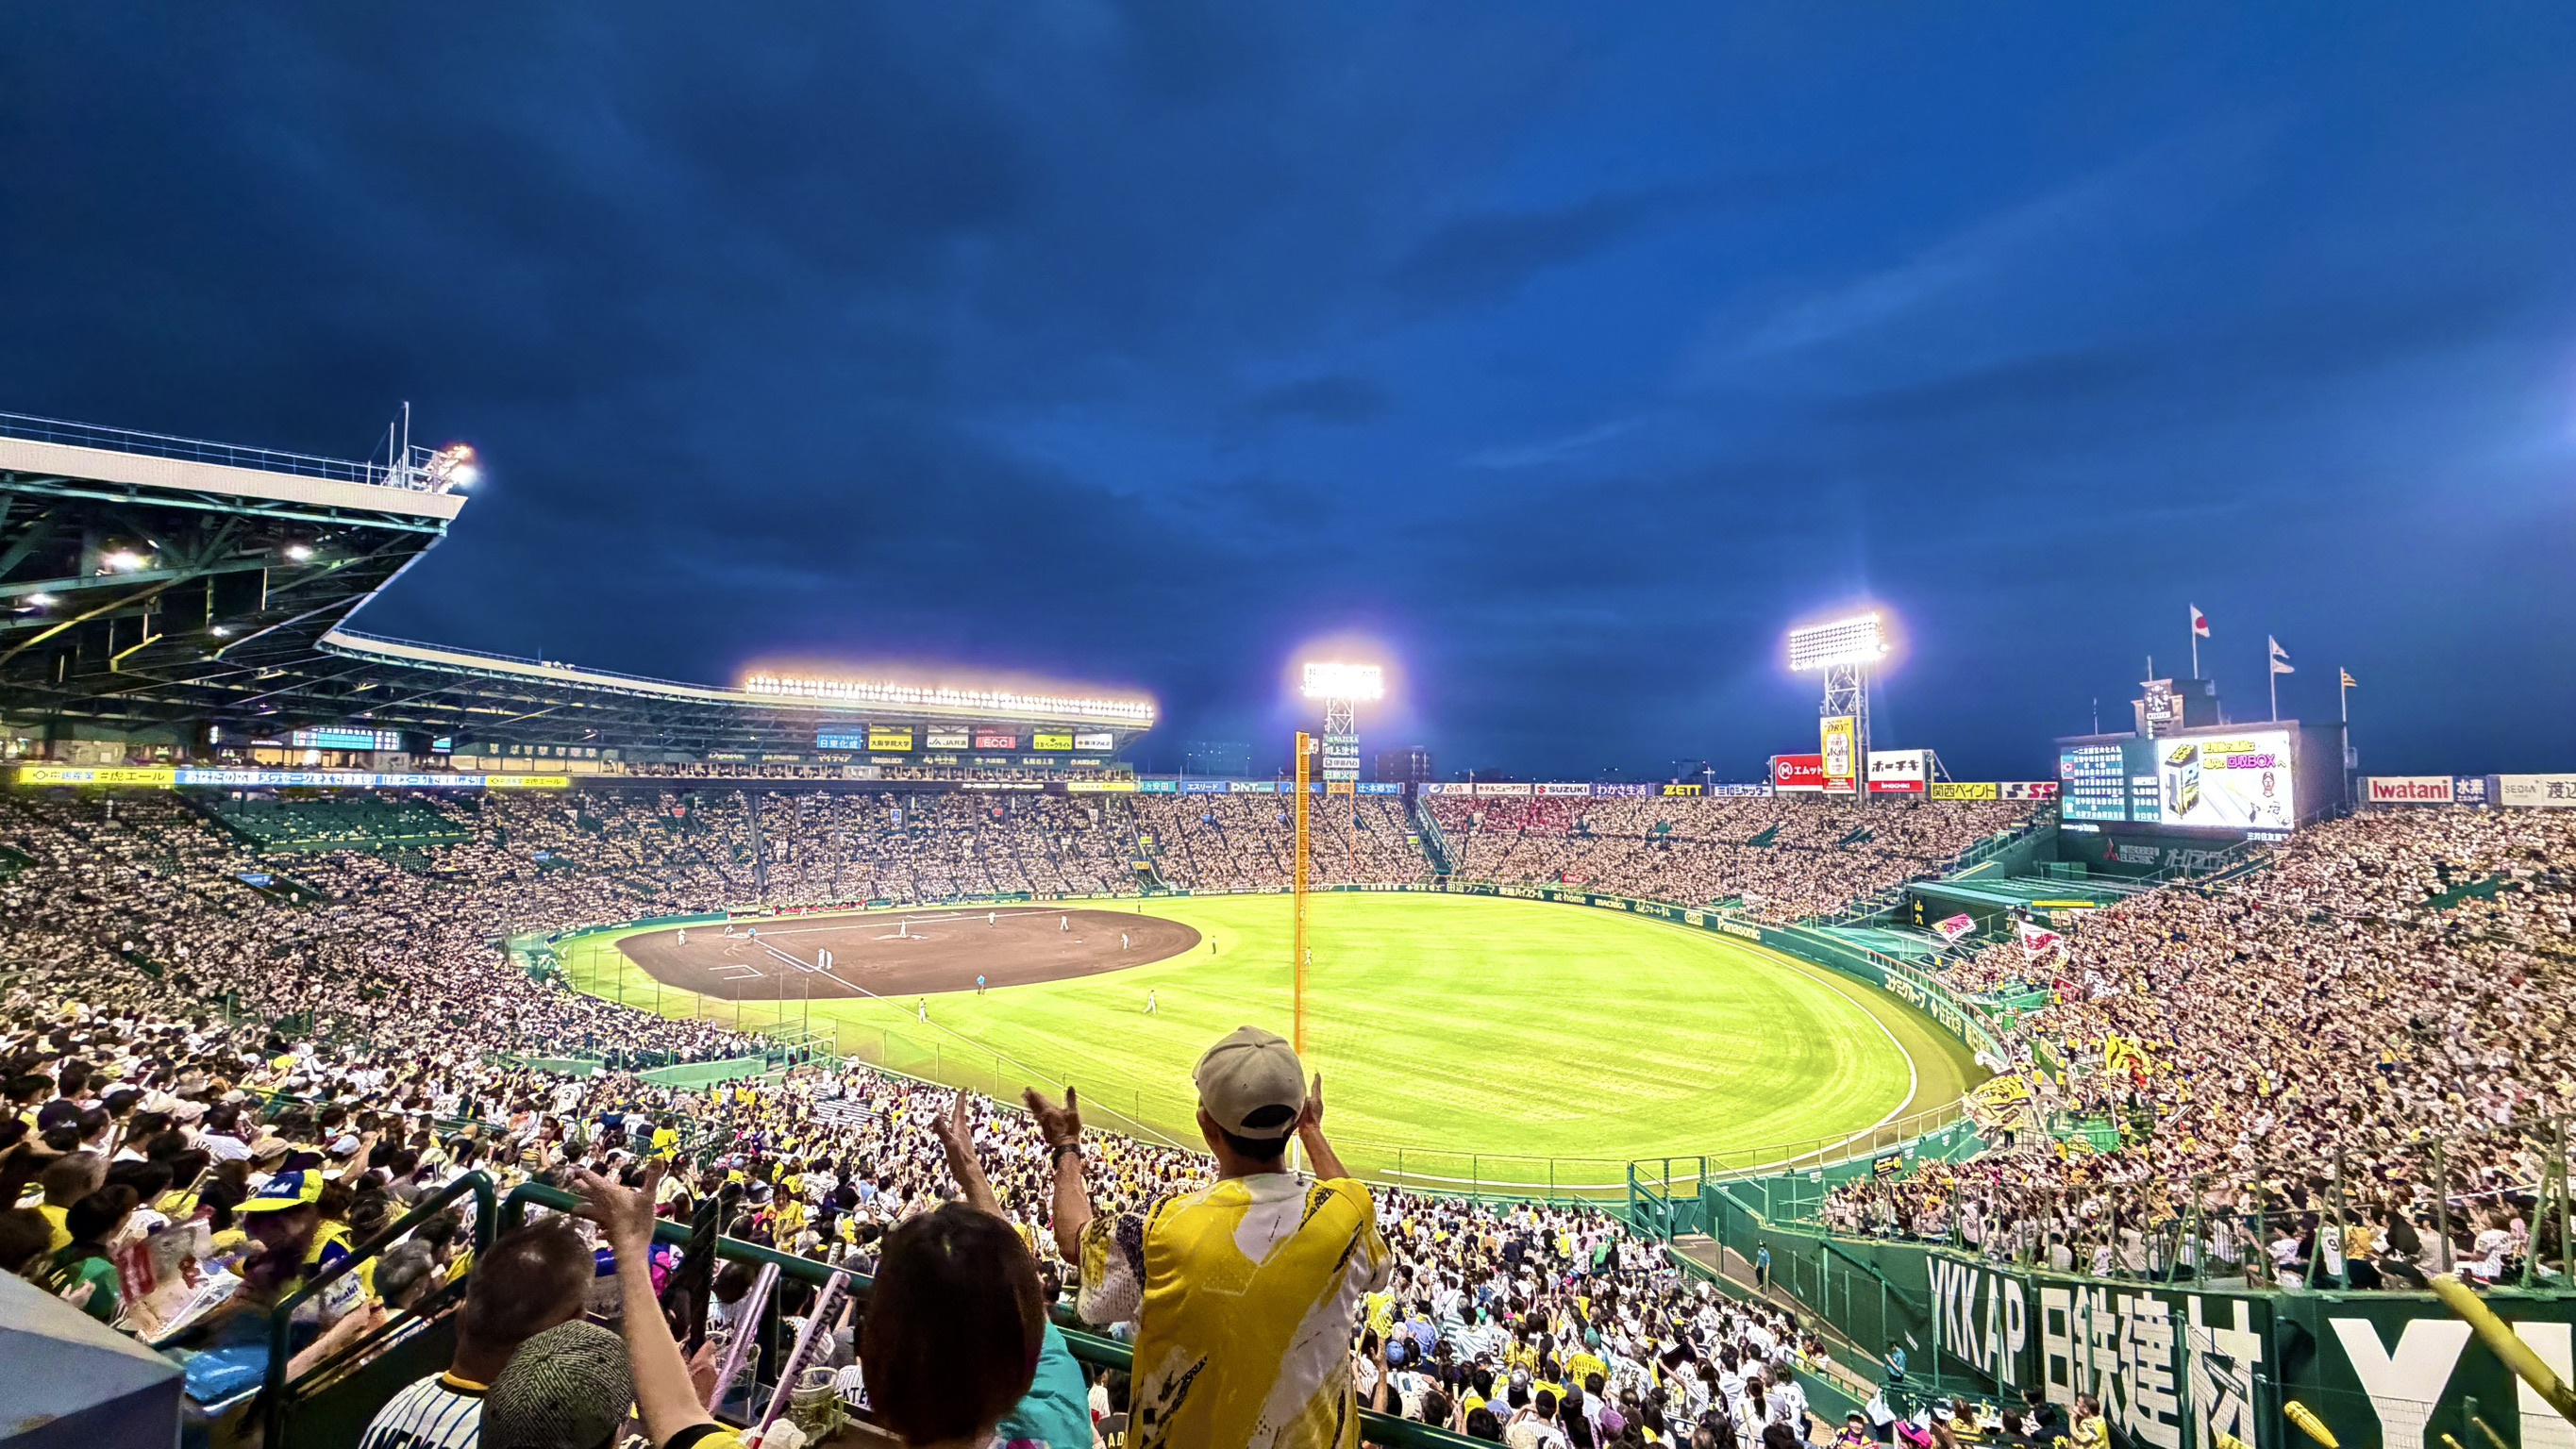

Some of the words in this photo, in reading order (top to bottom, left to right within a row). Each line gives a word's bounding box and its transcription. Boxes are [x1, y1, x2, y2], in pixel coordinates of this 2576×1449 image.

[819, 739, 859, 748] 日東化成
[983, 738, 1009, 747] ECC
[1871, 759, 1920, 773] ホーチキ
[1186, 782, 1218, 791] エスリード
[1230, 782, 1259, 791] DNT
[1478, 785, 1529, 793] ホテルニューアワジ
[1597, 784, 1647, 795] わかさ生活
[1663, 784, 1702, 796] ZETT
[1932, 784, 1995, 798] 関西ペイント
[2372, 780, 2449, 799] Iwatani
[2456, 779, 2484, 794] 水素
[1717, 916, 1761, 941] Panasonic
[2327, 1238, 2336, 1252] 9
[1927, 1255, 1982, 1371] YKK
[1983, 1274, 2026, 1387] AP
[792, 1282, 847, 1377] HANSHIN
[2039, 1284, 2264, 1449] 日鉄建材
